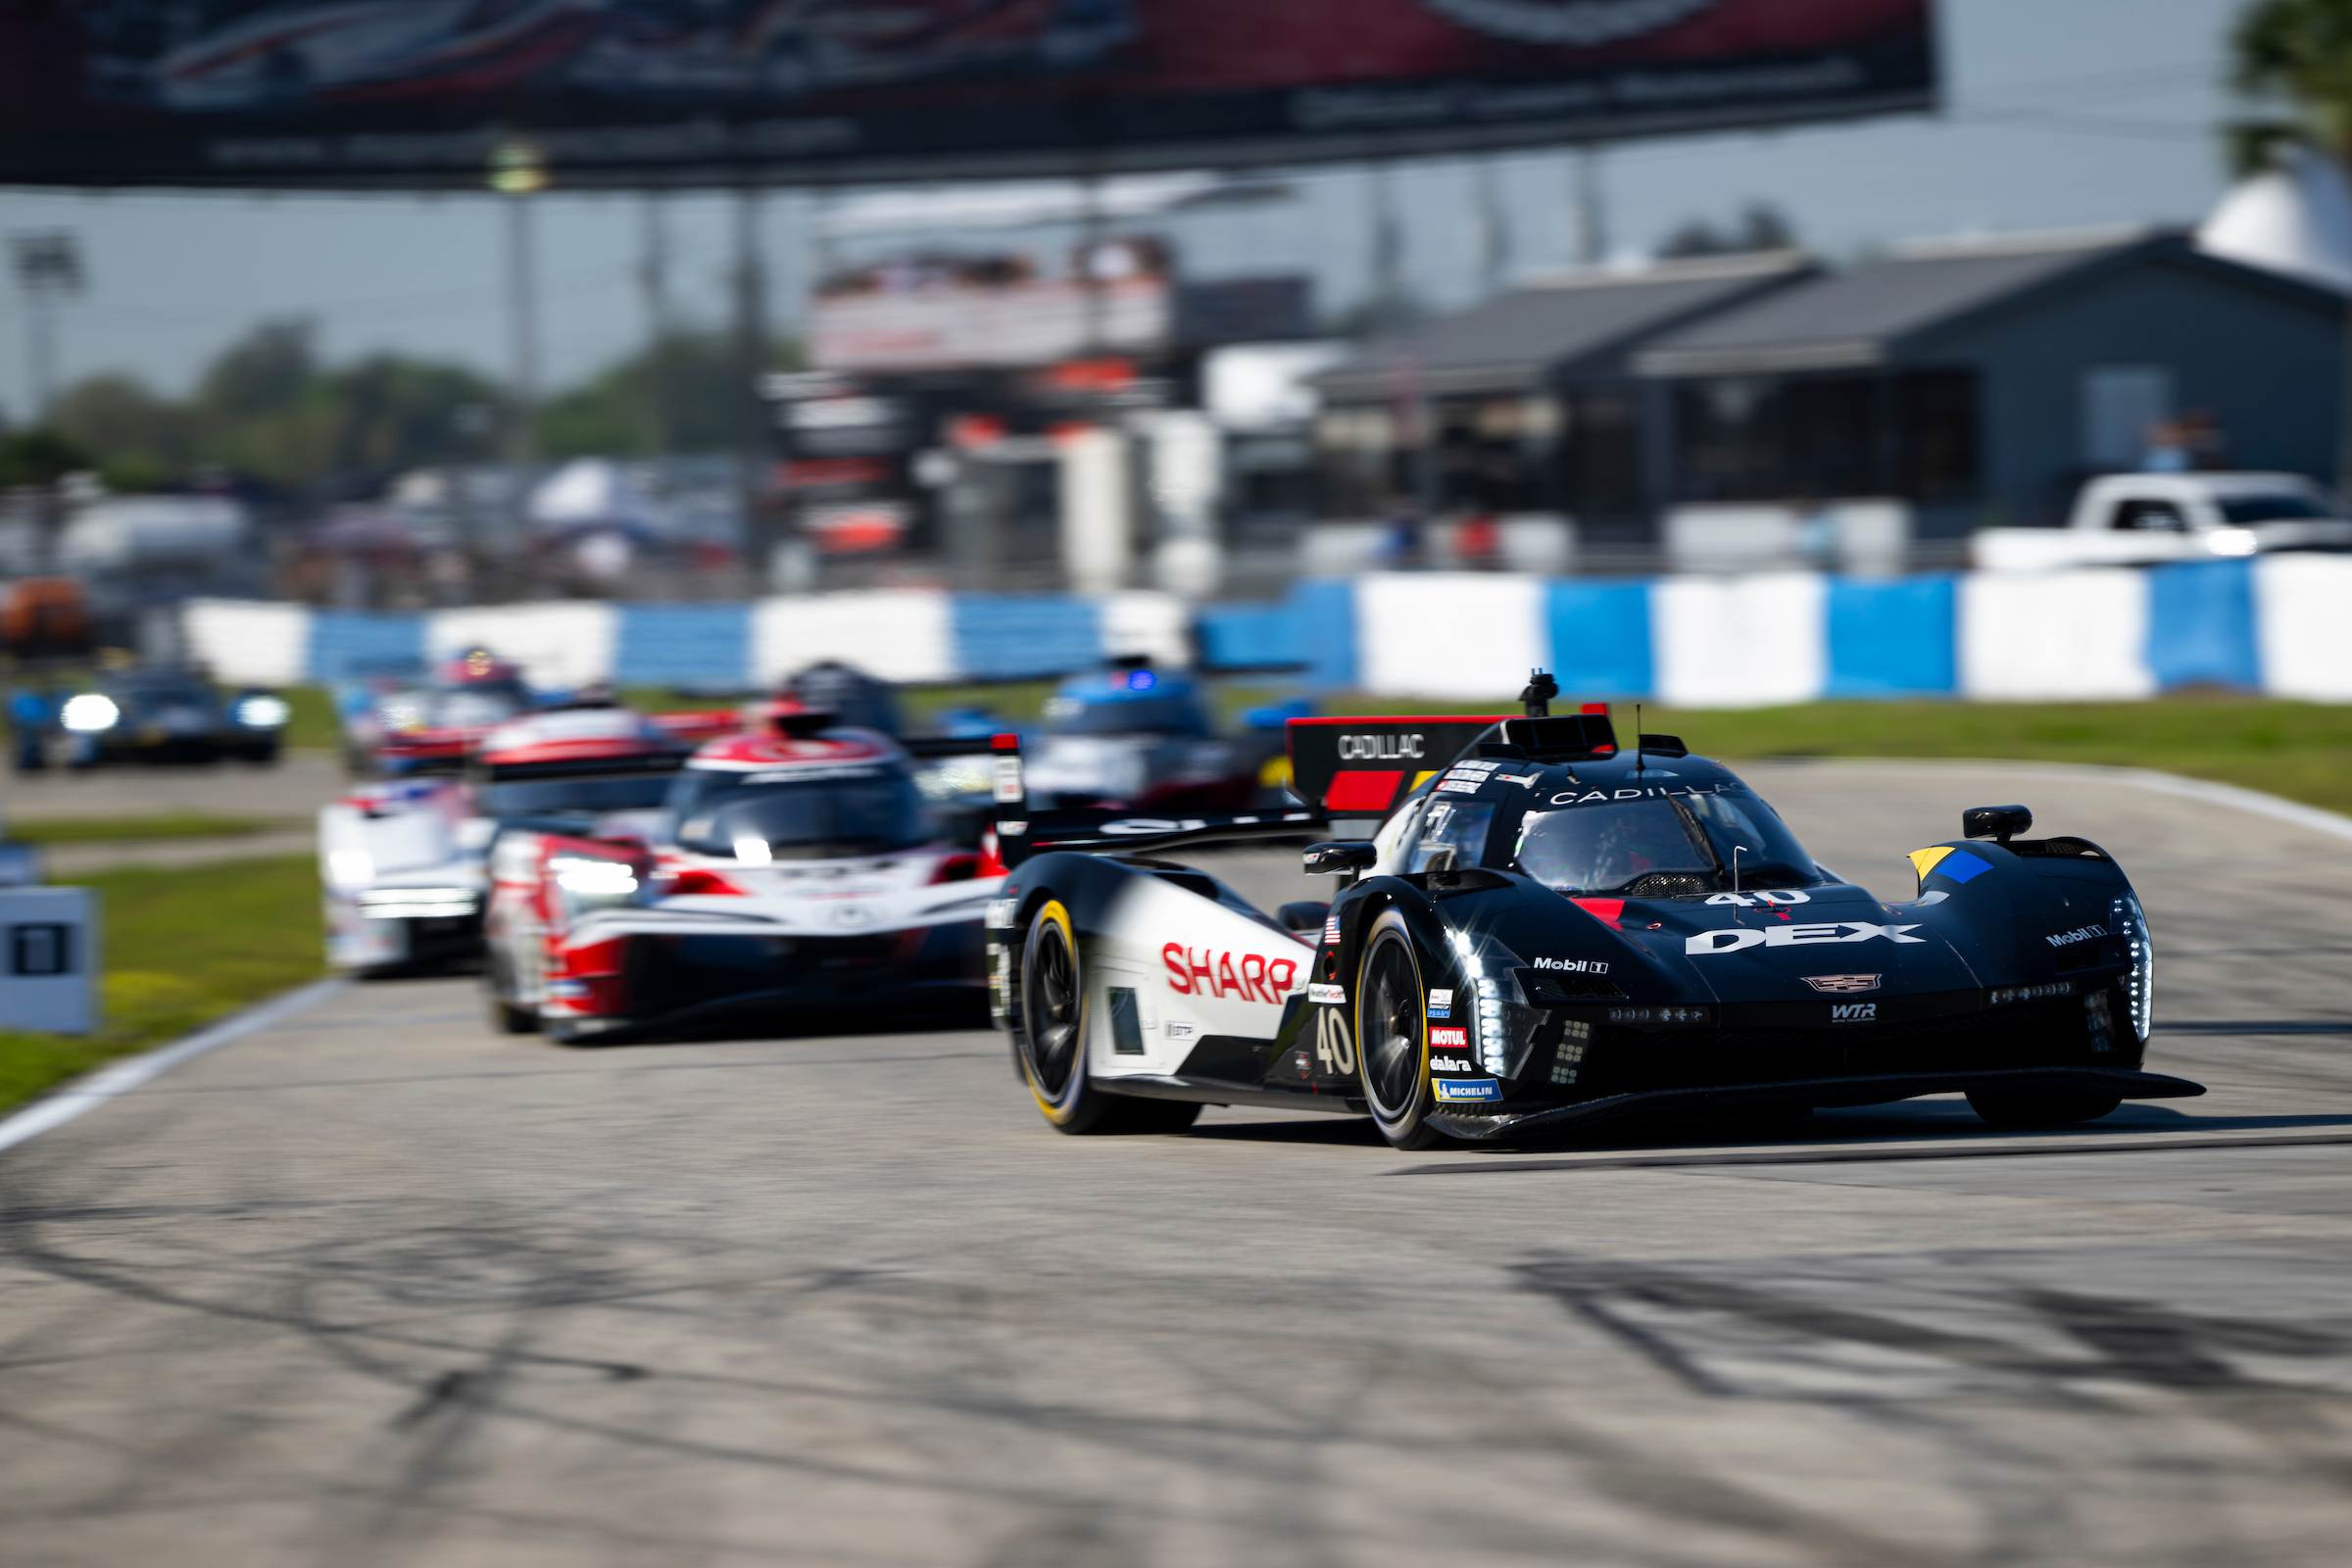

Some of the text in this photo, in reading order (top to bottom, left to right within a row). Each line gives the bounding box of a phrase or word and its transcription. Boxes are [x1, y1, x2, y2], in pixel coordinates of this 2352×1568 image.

[1338, 734, 1425, 760] CADILLAC
[1549, 782, 1747, 806] CADILLAC
[1704, 890, 1811, 907] 40
[1685, 921, 1927, 956] DEX
[2045, 927, 2093, 948] Mobil
[1162, 942, 1297, 1005] SHARP
[1533, 956, 1588, 972] Mobil
[1833, 1003, 1876, 1019] WTR
[1316, 1006, 1355, 1074] 40
[1431, 1029, 1466, 1046] MOTUL
[1429, 1054, 1472, 1072] dallara
[1449, 1086, 1494, 1096] MICHELIN
